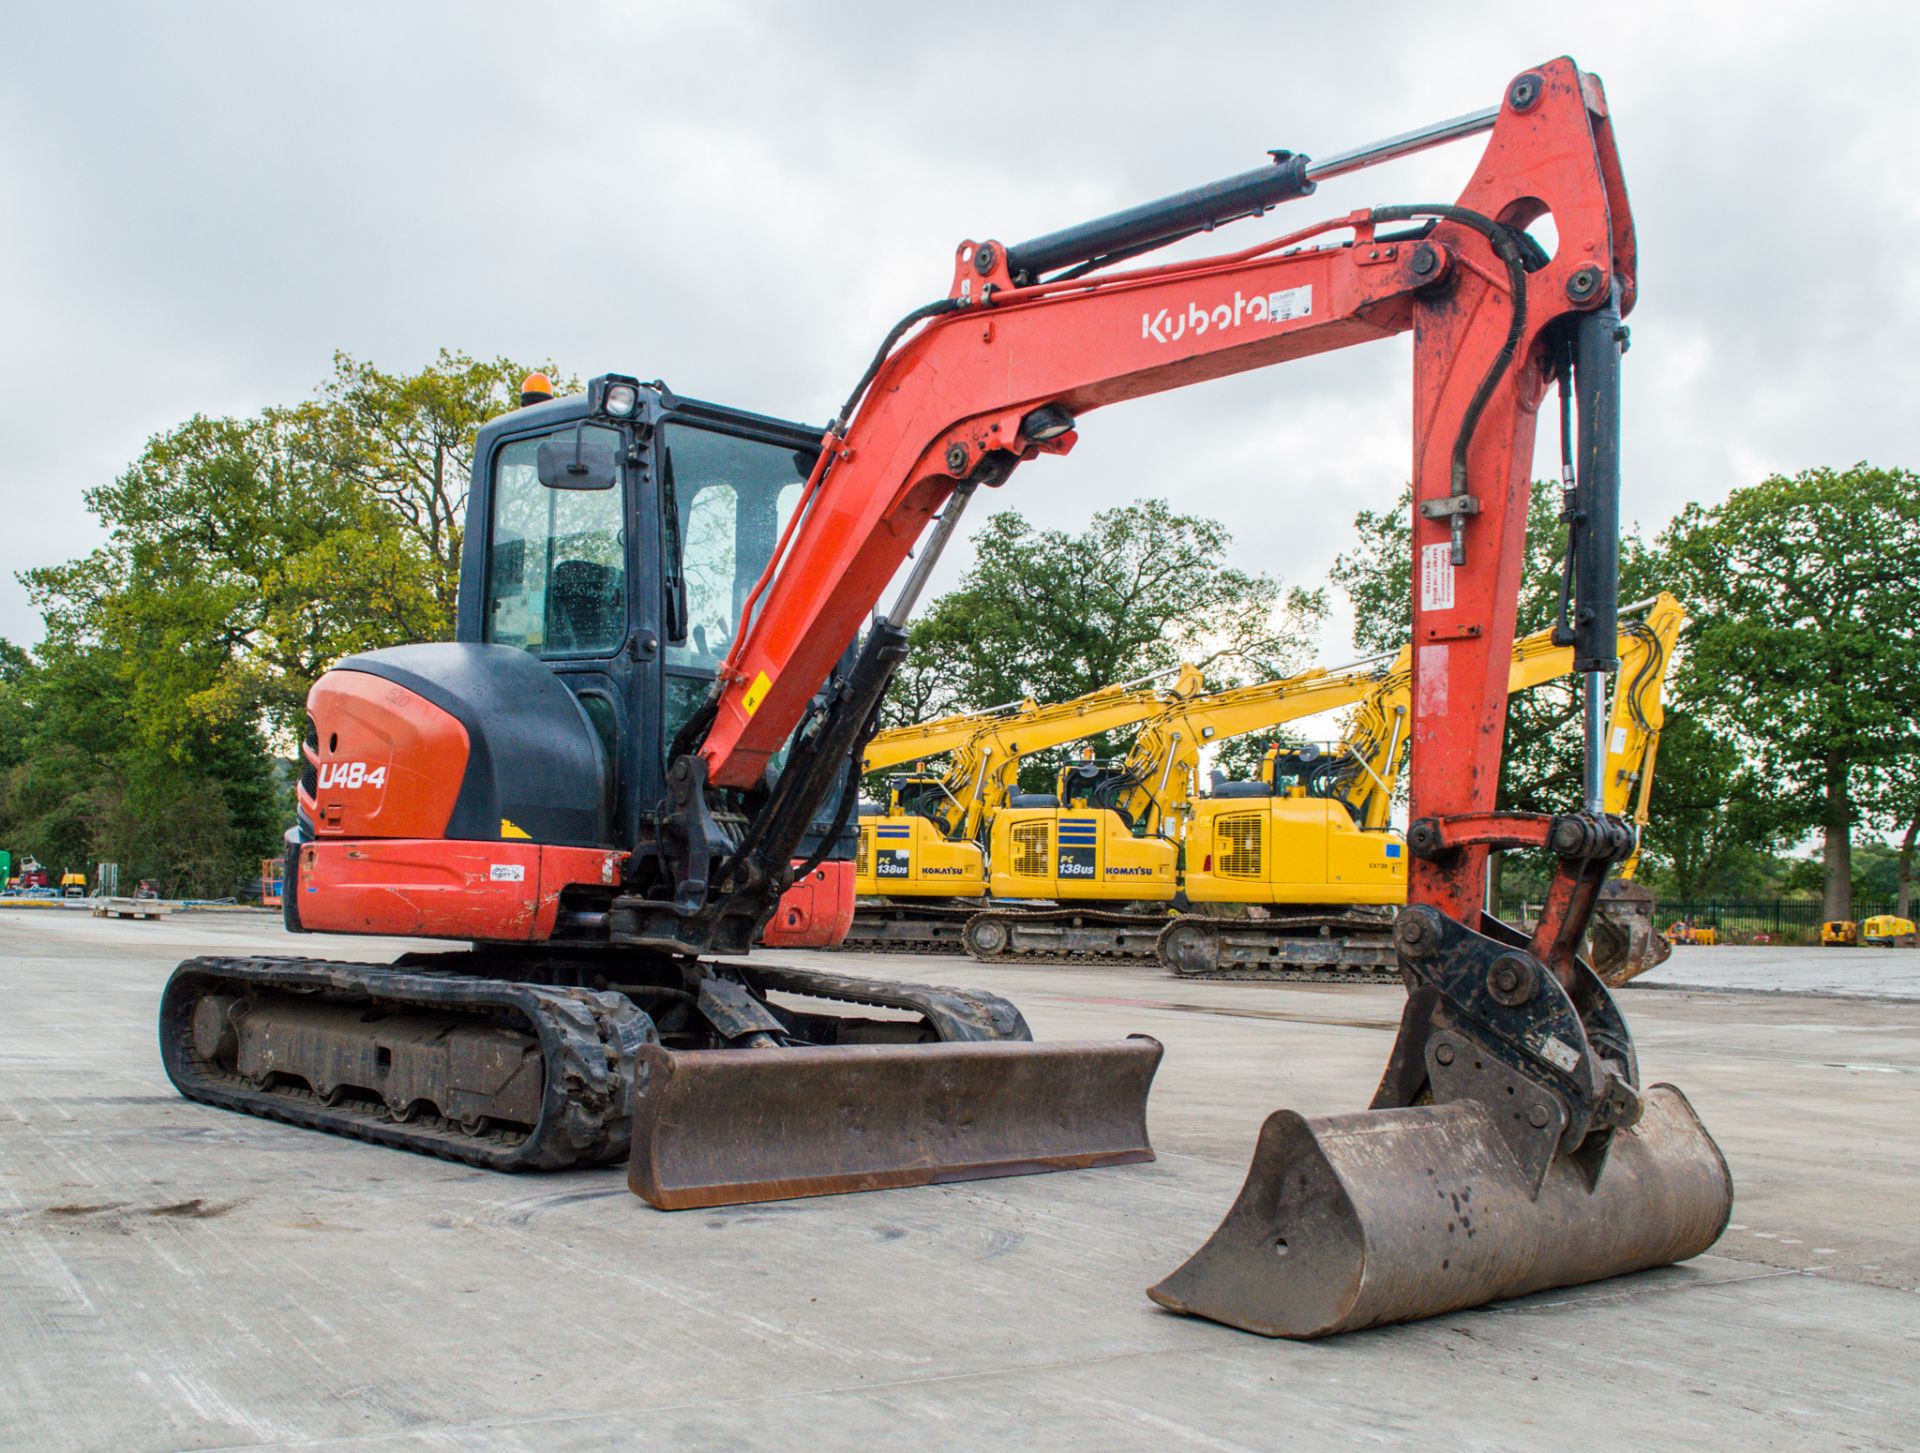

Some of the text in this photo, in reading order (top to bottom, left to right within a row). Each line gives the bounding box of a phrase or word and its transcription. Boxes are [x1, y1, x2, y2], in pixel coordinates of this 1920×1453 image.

[1142, 291, 1268, 343] Kubota
[318, 762, 387, 789] U48-4
[1060, 855, 1074, 863] PC
[921, 867, 963, 875] KOMATSU
[1105, 866, 1153, 876] KOMATSU
